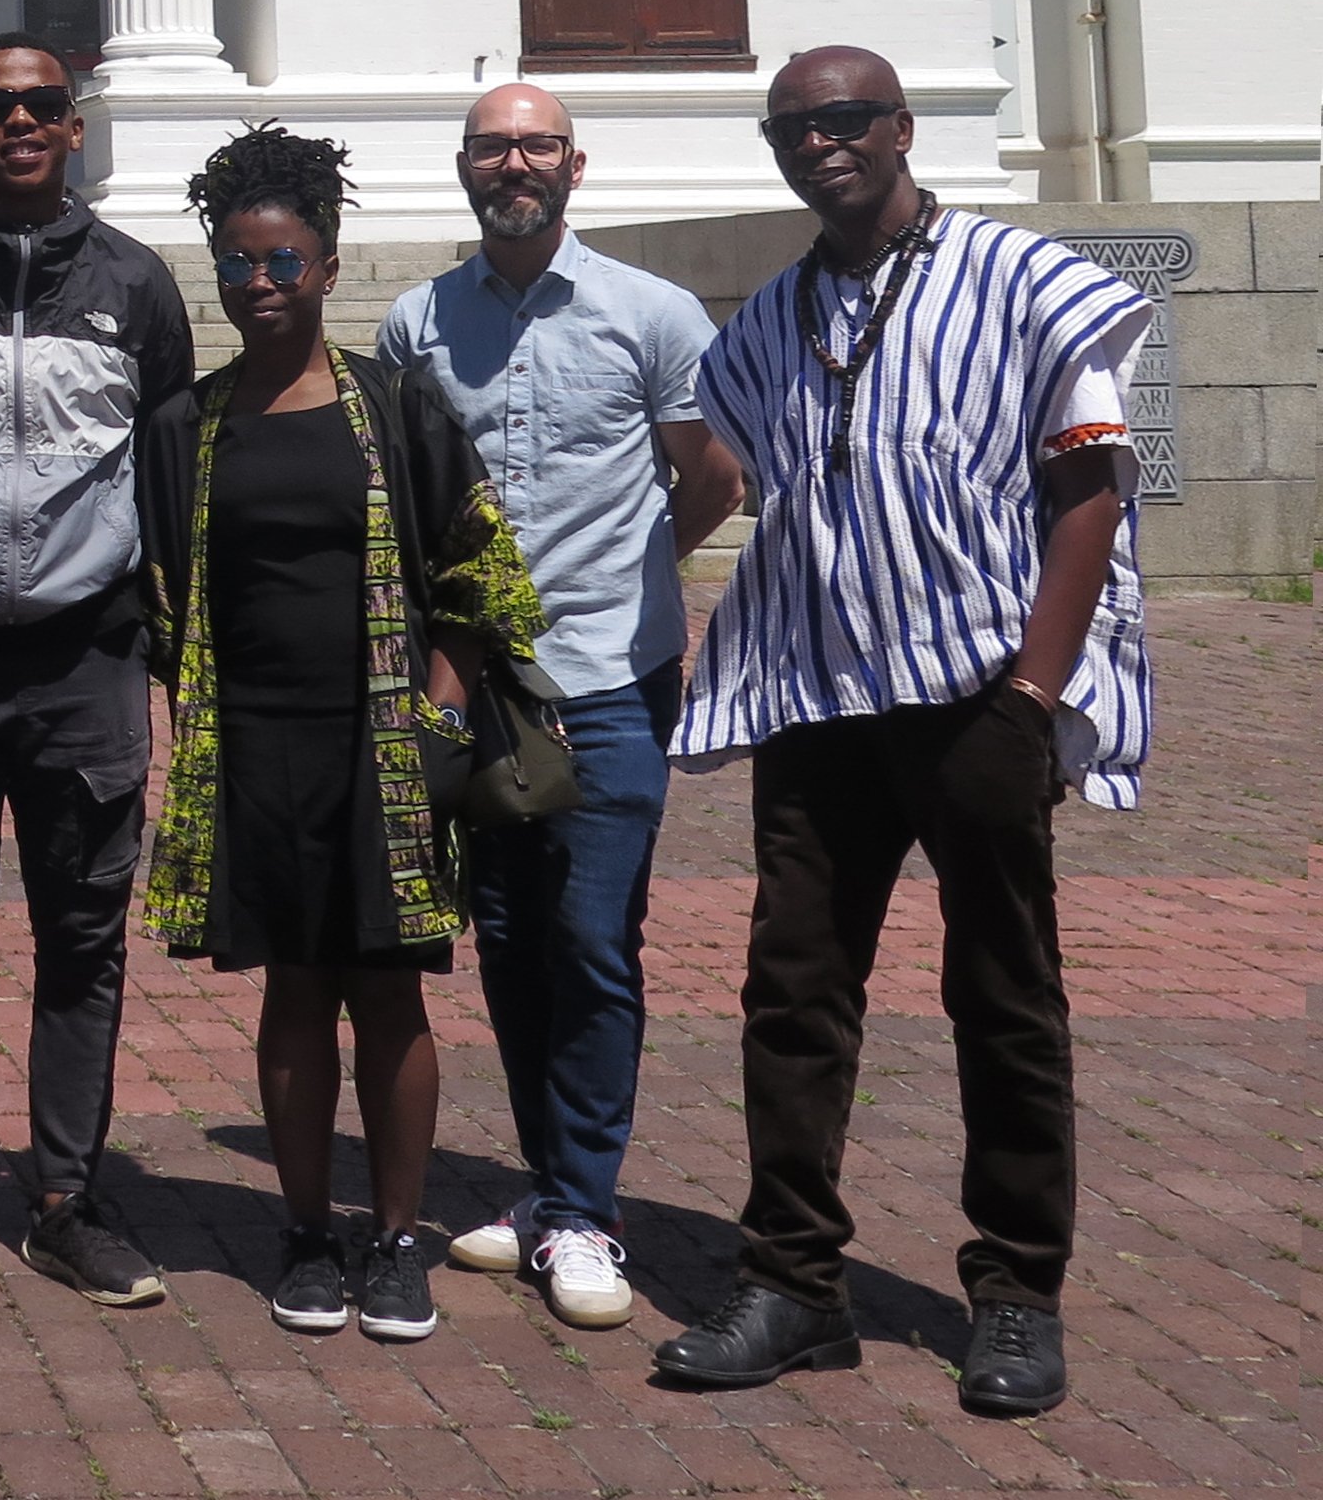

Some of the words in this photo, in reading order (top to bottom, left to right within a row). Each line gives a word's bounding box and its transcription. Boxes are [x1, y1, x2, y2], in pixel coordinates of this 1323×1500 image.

[1145, 327, 1166, 342] RY
[1130, 389, 1170, 405] ARI
[1132, 404, 1171, 419] ZWE
